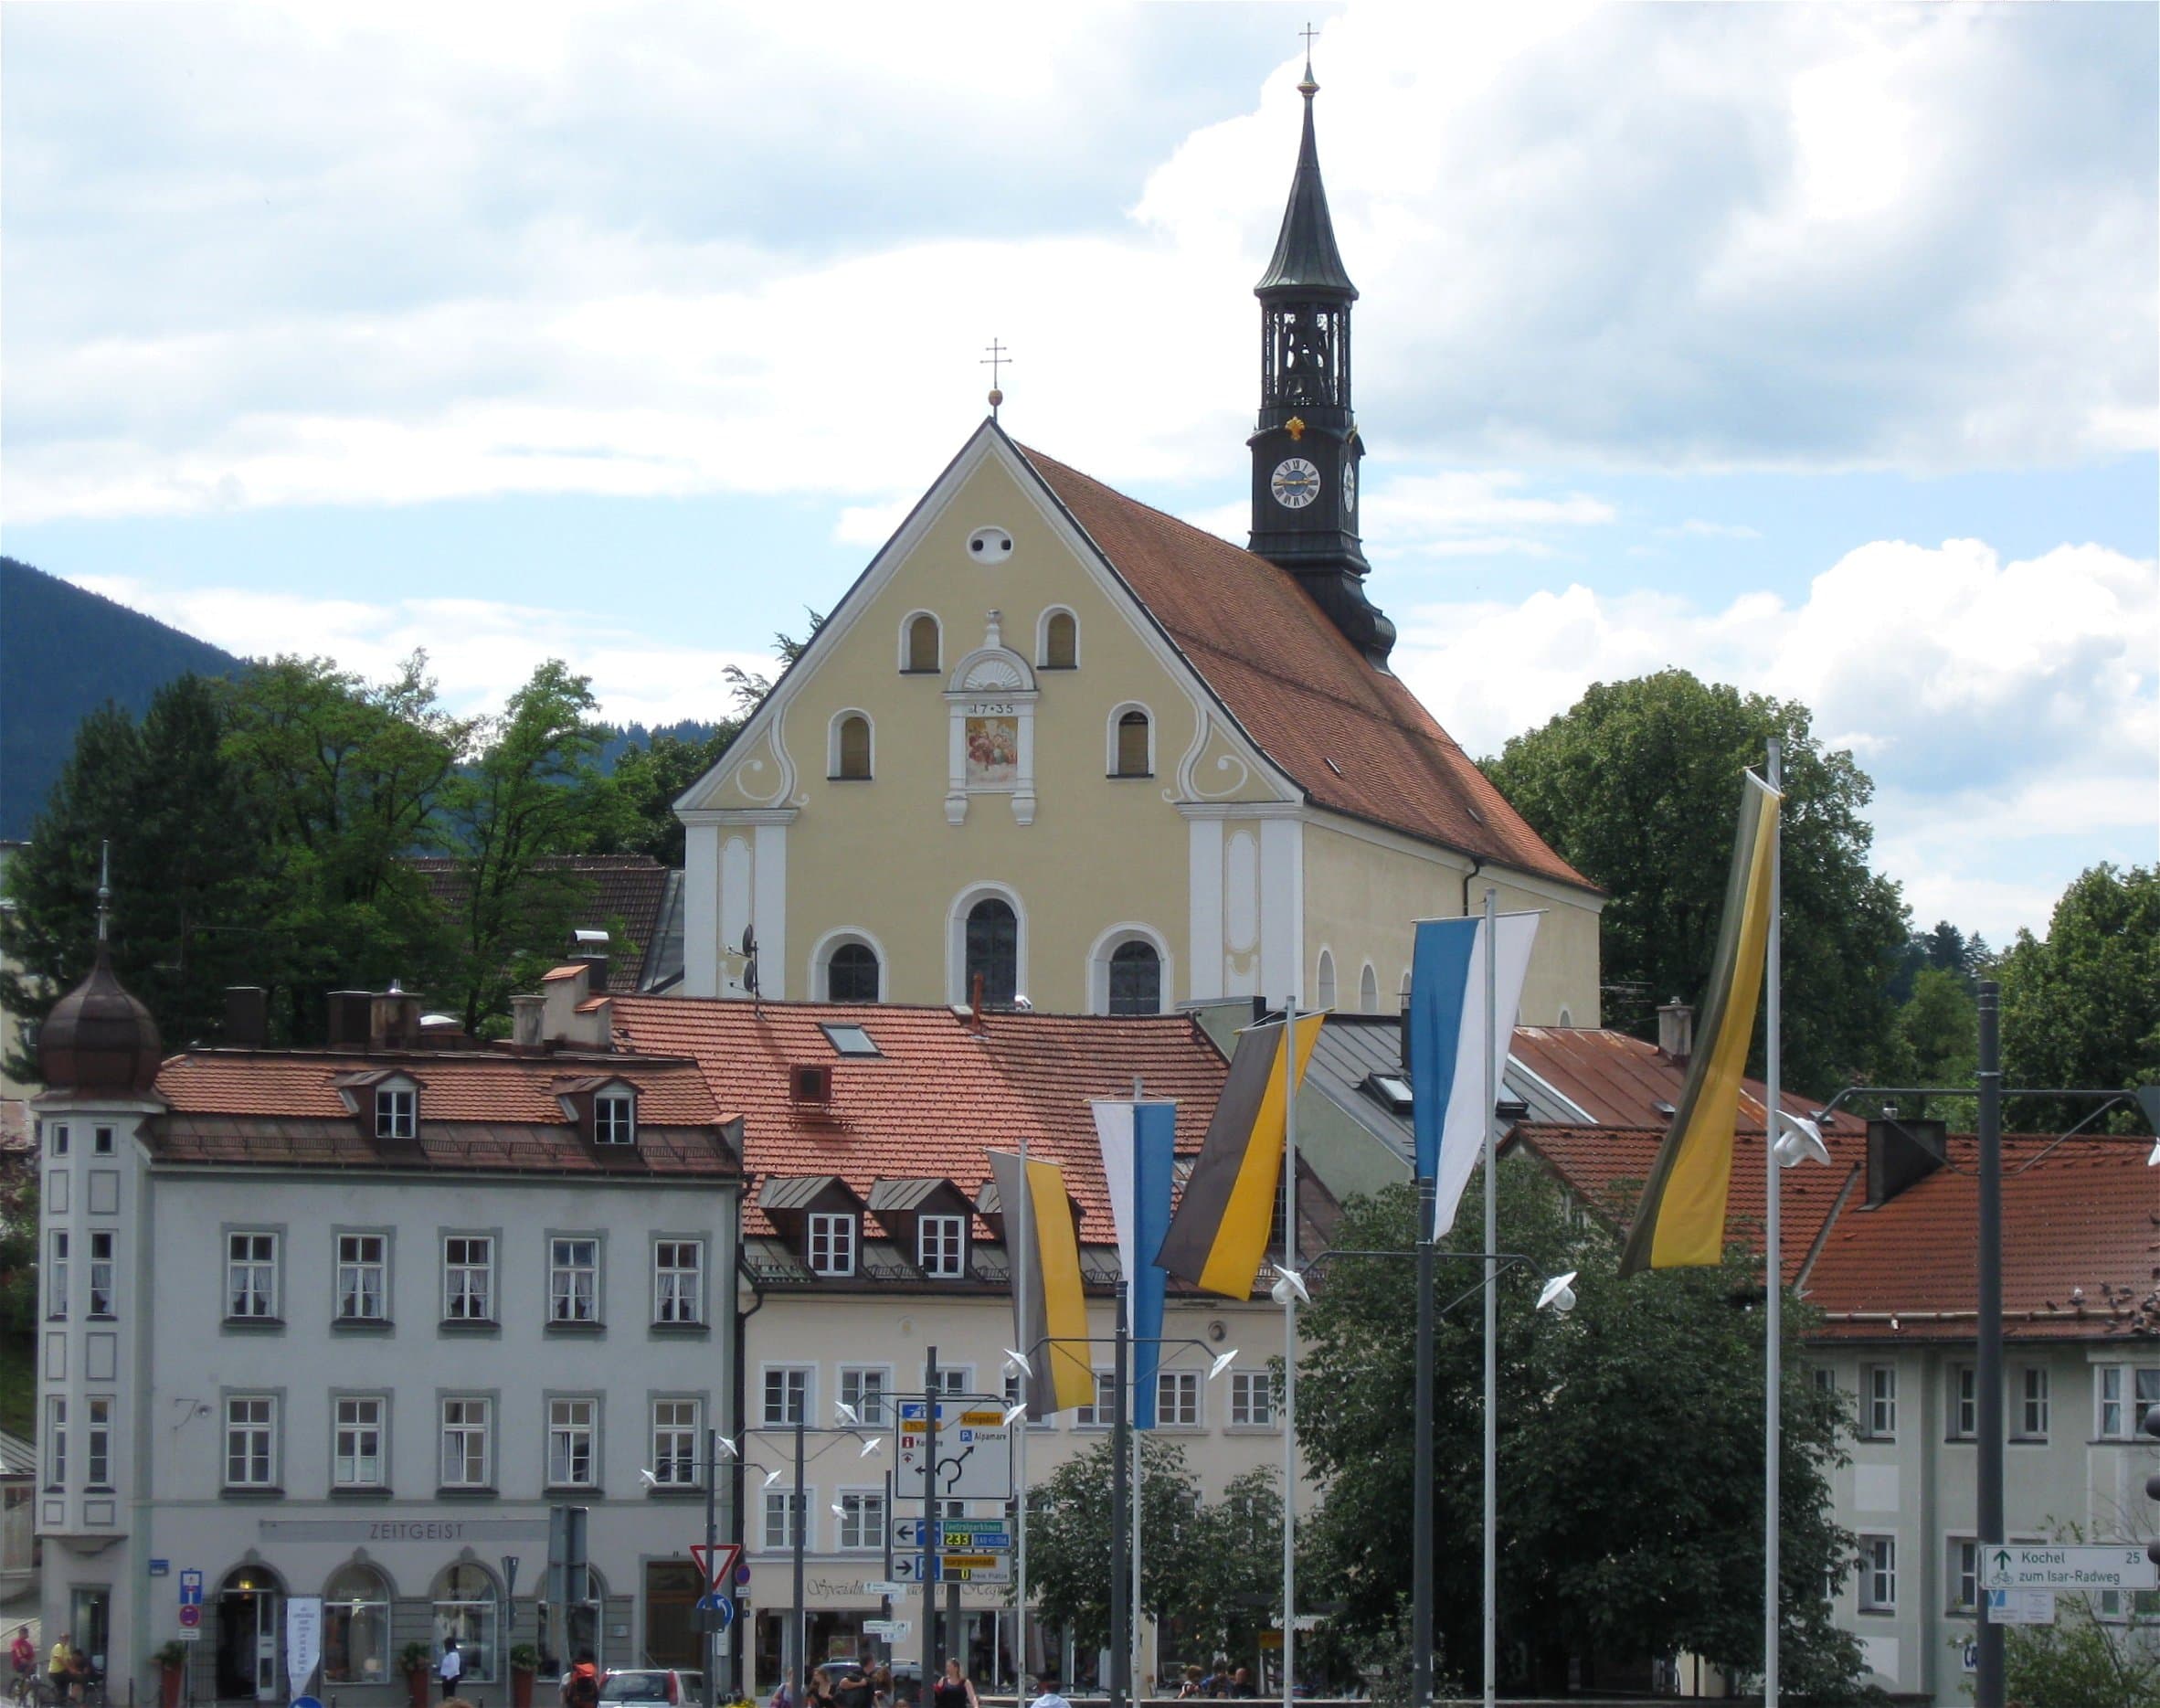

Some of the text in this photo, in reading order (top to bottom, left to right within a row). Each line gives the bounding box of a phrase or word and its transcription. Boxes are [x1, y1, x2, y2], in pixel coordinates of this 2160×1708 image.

[974, 1432, 1007, 1442] Alpamare
[370, 1523, 463, 1540] ZEITGEIST
[946, 1533, 969, 1545] 233
[2021, 1552, 2141, 1564] Kochel 25
[2019, 1570, 2121, 1584] zum Isar-Radweg
